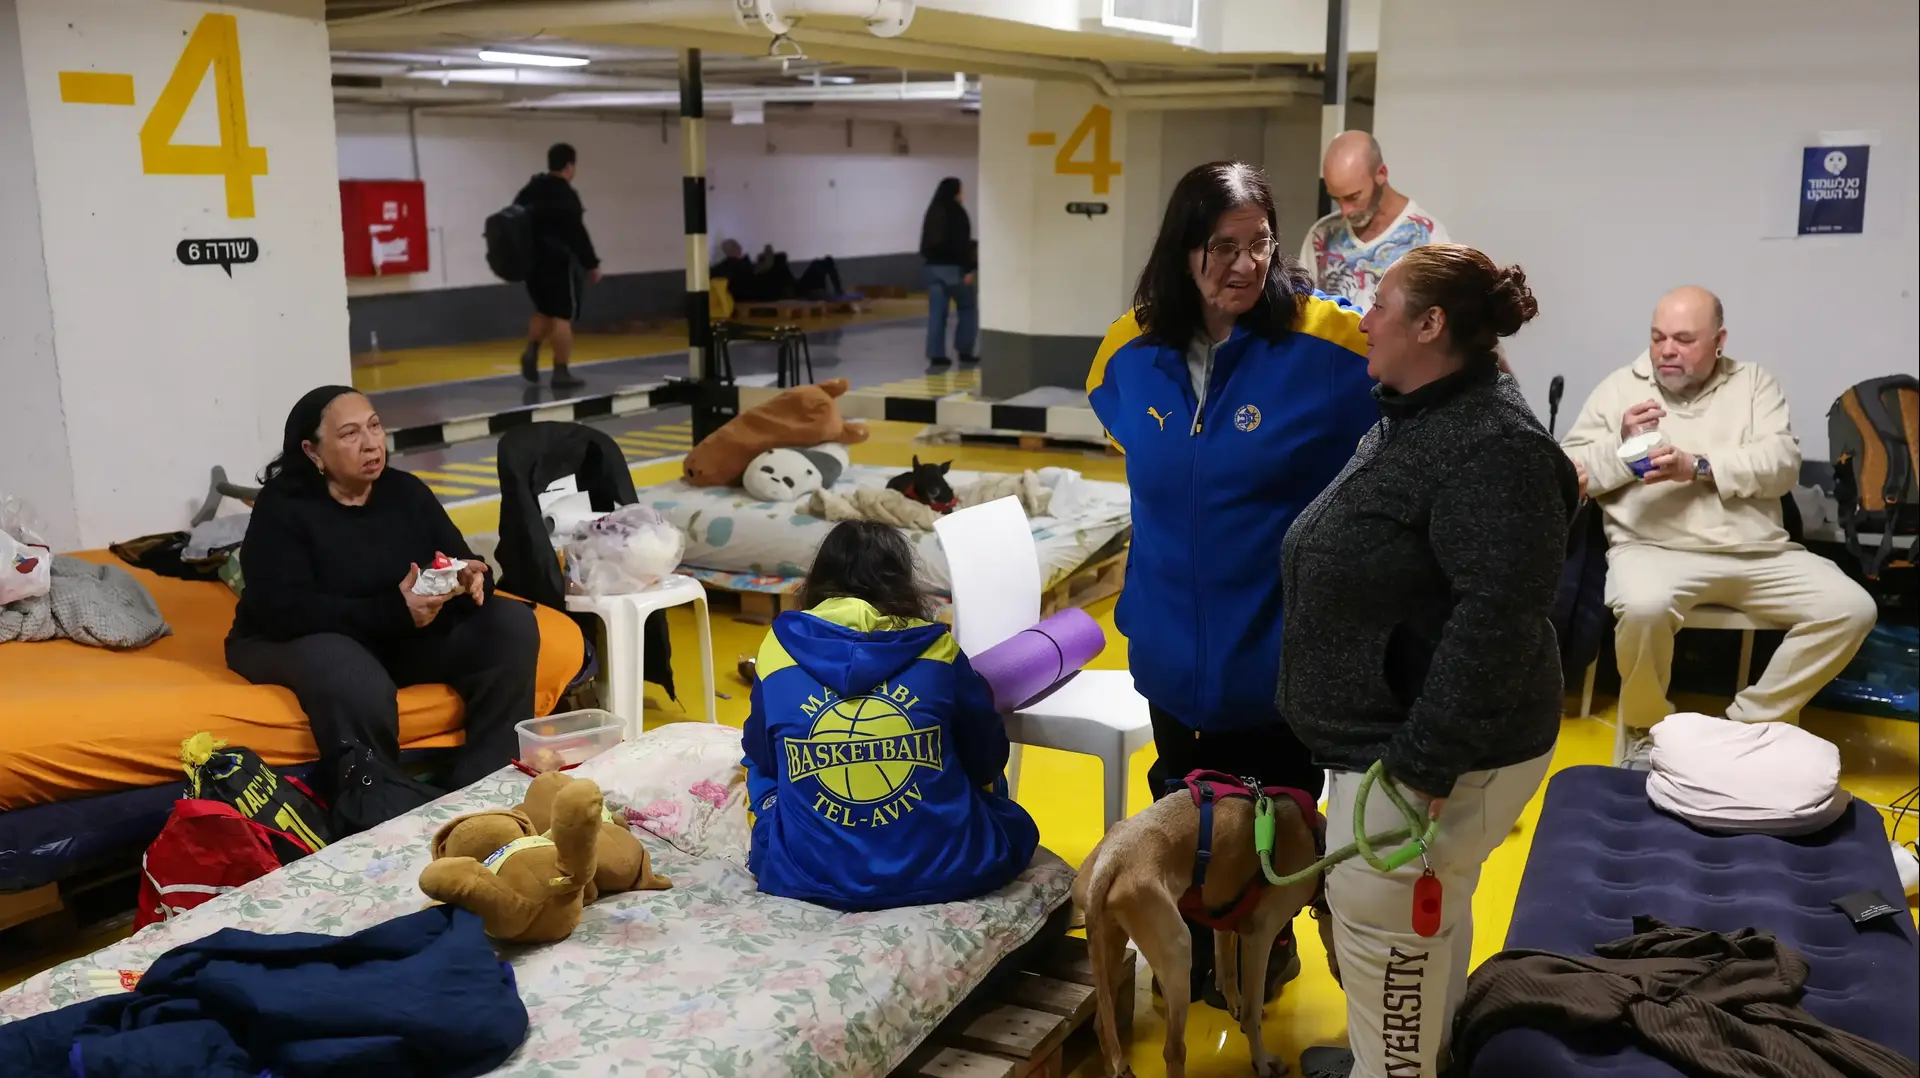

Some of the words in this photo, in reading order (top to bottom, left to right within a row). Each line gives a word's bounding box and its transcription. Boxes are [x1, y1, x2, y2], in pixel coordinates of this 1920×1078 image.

[1846, 177, 1860, 189] נא
[1843, 187, 1859, 199] על
[188, 243, 200, 260] 6
[206, 241, 249, 260] שורה
[800, 680, 919, 718] MAABI
[787, 732, 938, 776] BASKETBALL
[812, 782, 922, 827] TEL-AVIV
